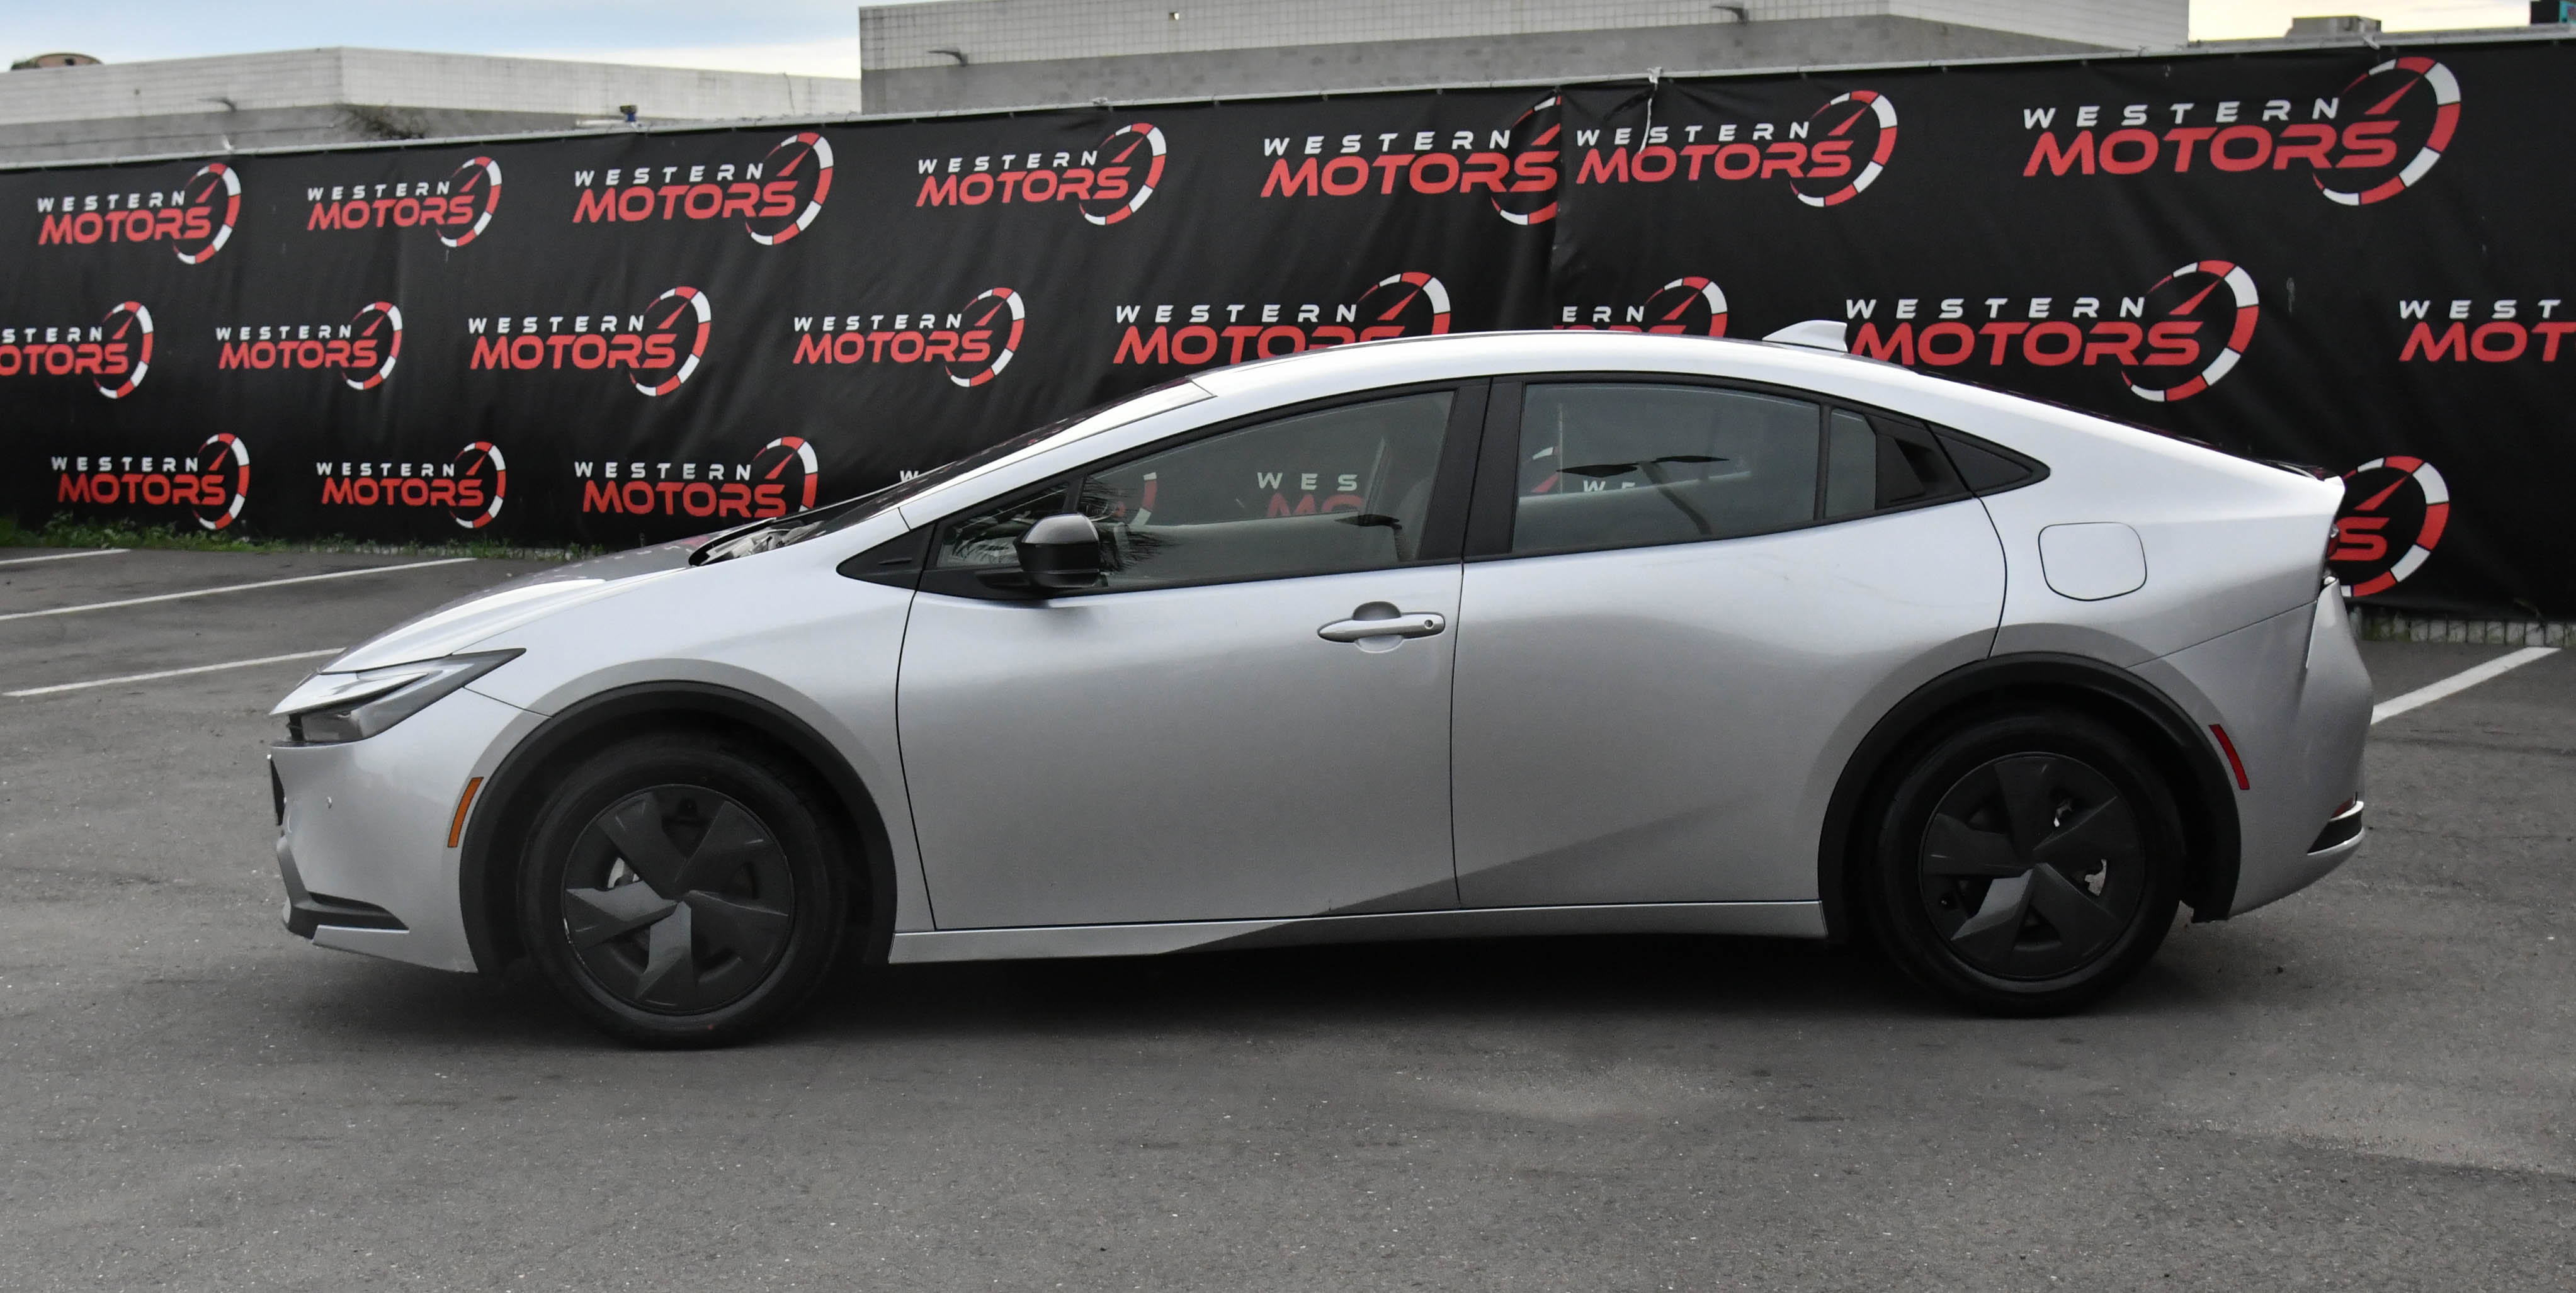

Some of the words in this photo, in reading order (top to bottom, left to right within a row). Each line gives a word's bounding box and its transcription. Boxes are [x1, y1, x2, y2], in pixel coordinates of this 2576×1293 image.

[2024, 98, 2339, 130] WESTERN
[1264, 130, 1511, 157] WESTERN
[1576, 121, 1809, 146] WESTERN
[918, 150, 1098, 174] WESTERN
[1576, 140, 1853, 184] MOTORS
[2023, 120, 2402, 177] MOTORS
[575, 162, 764, 187] WESTERN
[916, 166, 1131, 207] MOTORS
[1261, 150, 1560, 197] MOTORS
[37, 190, 185, 213] WESTERN
[307, 181, 450, 201] WESTERN
[573, 181, 798, 223] MOTORS
[38, 206, 211, 245] MOTORS
[307, 195, 474, 230] MOTORS
[1116, 304, 1357, 324] WESTERN
[1562, 305, 1645, 322] ERN
[1846, 296, 2145, 319] WESTERN
[2400, 299, 2561, 319] WEST
[2, 327, 102, 344] STERN
[215, 324, 351, 341] WESTERN
[468, 315, 644, 334] WESTERN
[794, 313, 962, 332] WESTERN
[218, 339, 378, 370] MOTORS
[470, 333, 677, 370] MOTORS
[793, 329, 993, 364] MOTORS
[1851, 320, 2203, 366] MOTORS
[2400, 321, 2576, 363] MOT
[0, 342, 129, 376] OTORS
[52, 457, 198, 472] WESTERN
[316, 462, 455, 477] WESTERN
[574, 461, 751, 481] WESTERN
[58, 473, 226, 506] MOTORS
[322, 477, 484, 507] MOTORS
[583, 480, 786, 518] MOTORS
